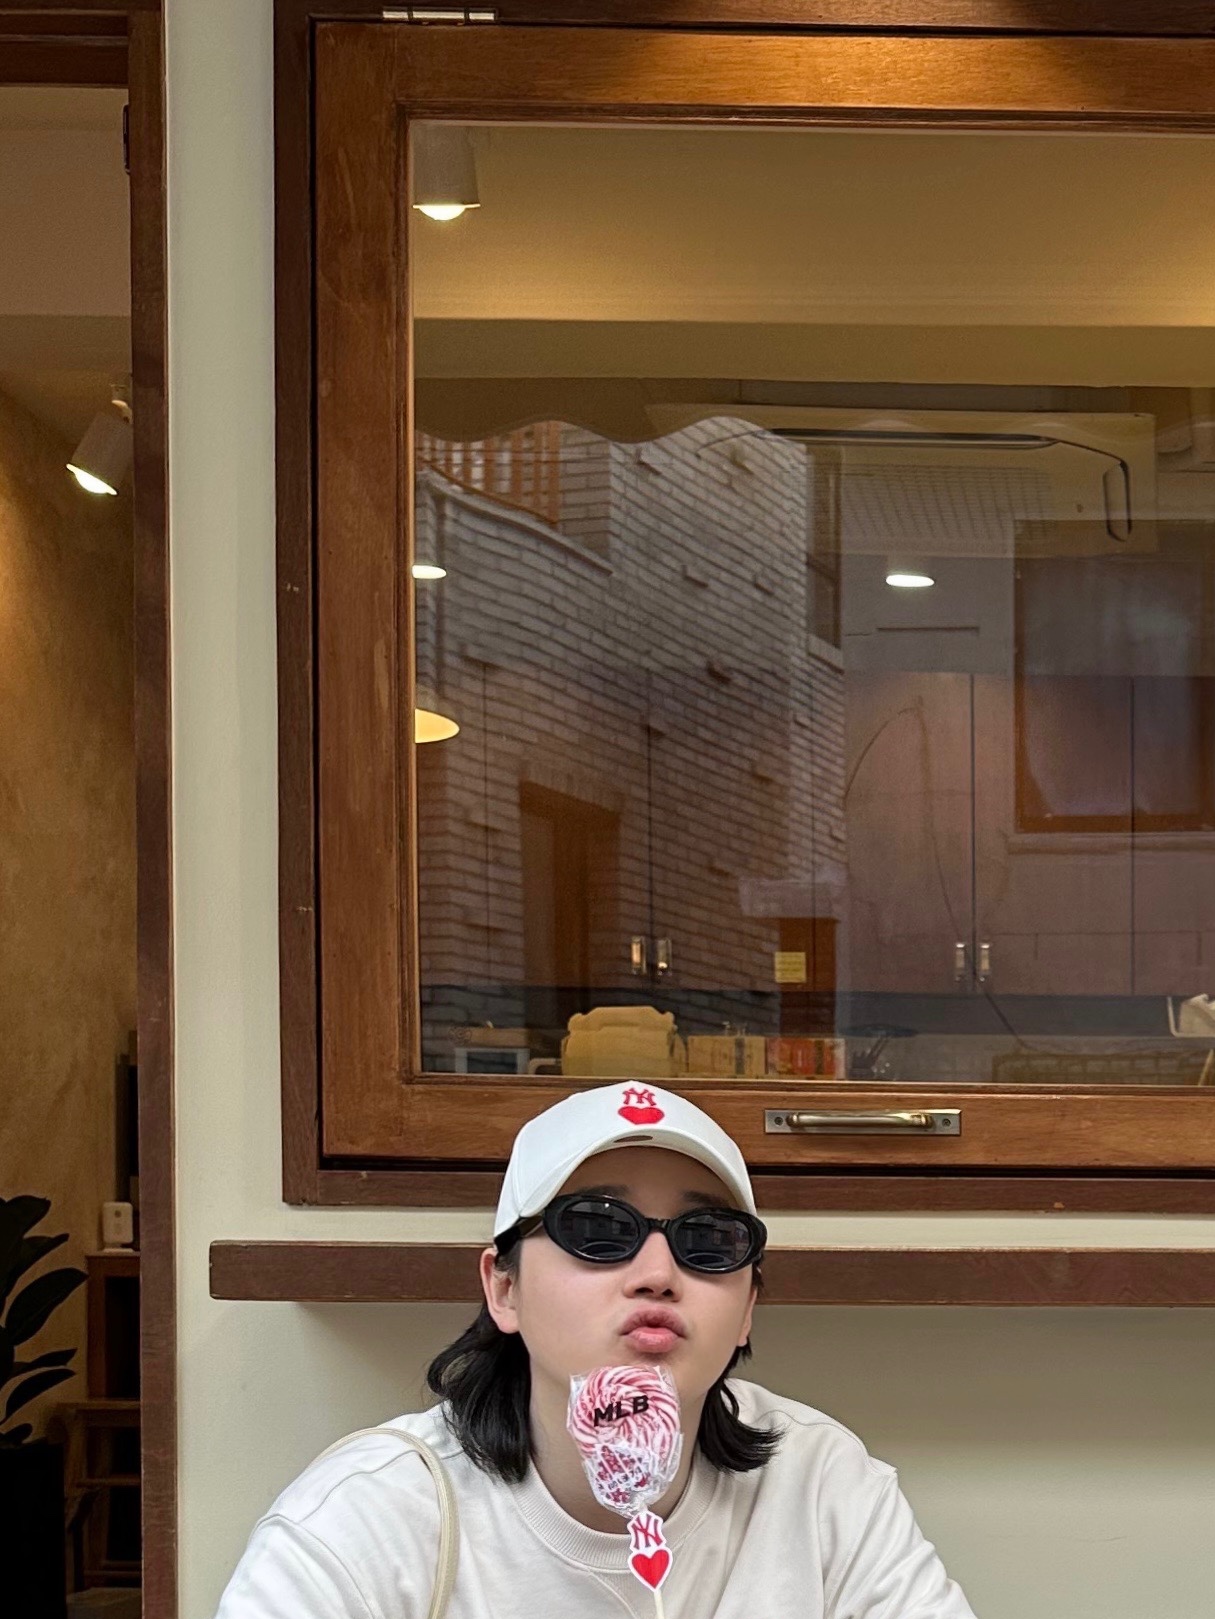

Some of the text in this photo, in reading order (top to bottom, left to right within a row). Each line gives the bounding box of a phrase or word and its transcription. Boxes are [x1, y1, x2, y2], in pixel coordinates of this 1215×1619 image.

[623, 1088, 657, 1106] NY
[593, 1395, 649, 1427] MLB
[631, 1514, 663, 1549] NY
